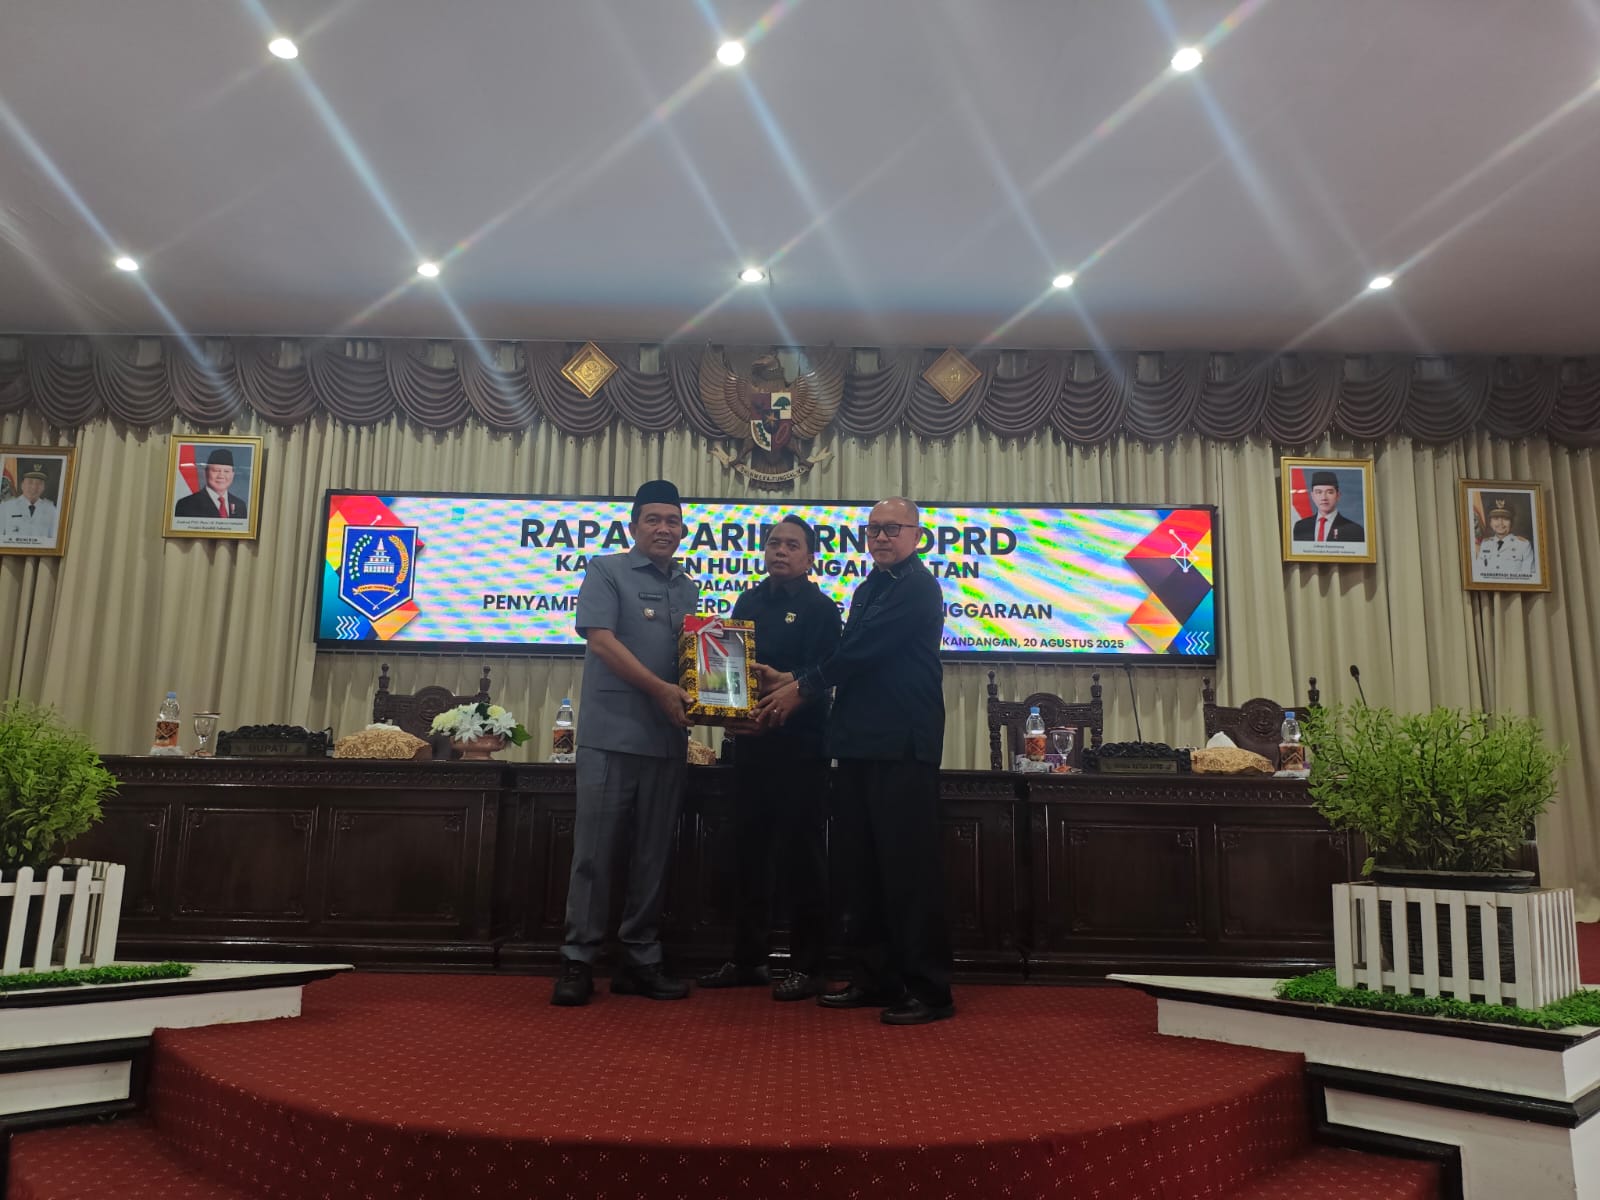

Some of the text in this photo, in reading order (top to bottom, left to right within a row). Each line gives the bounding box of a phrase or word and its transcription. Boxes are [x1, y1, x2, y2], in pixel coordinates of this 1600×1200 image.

[521, 518, 630, 549] RAPA
[917, 526, 1017, 556] DPRD
[708, 557, 767, 576] HULU
[806, 559, 867, 577] NGAI
[693, 580, 746, 592] DALAM
[483, 594, 579, 612] PENYAMP
[942, 636, 1125, 650] KANDANGAN, 20 AGUSTUS 2025
